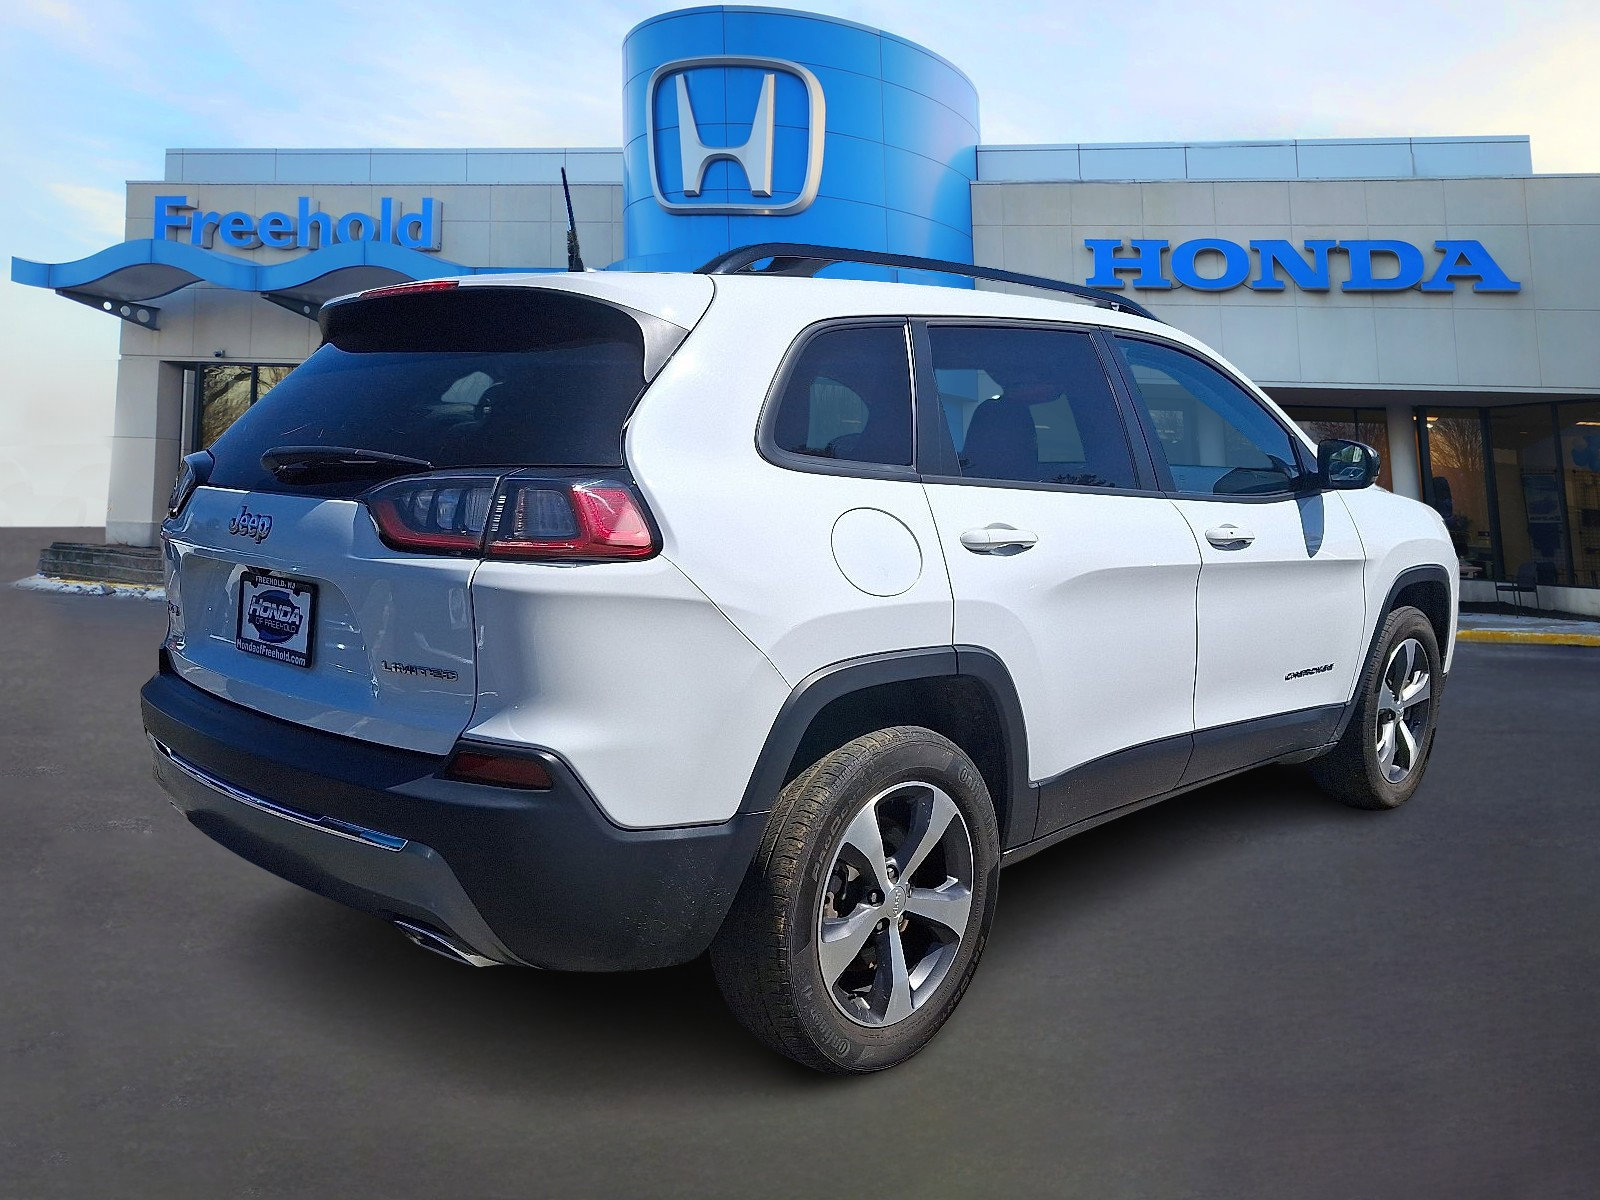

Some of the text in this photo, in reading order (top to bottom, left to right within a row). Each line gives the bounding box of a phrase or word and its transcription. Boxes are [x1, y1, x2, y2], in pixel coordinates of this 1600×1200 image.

[154, 196, 443, 252] Freehold
[1084, 238, 1522, 293] HONDA
[229, 505, 273, 545] Jeep
[249, 597, 300, 625] HONDA
[236, 638, 307, 667] HondaofFreehold.com
